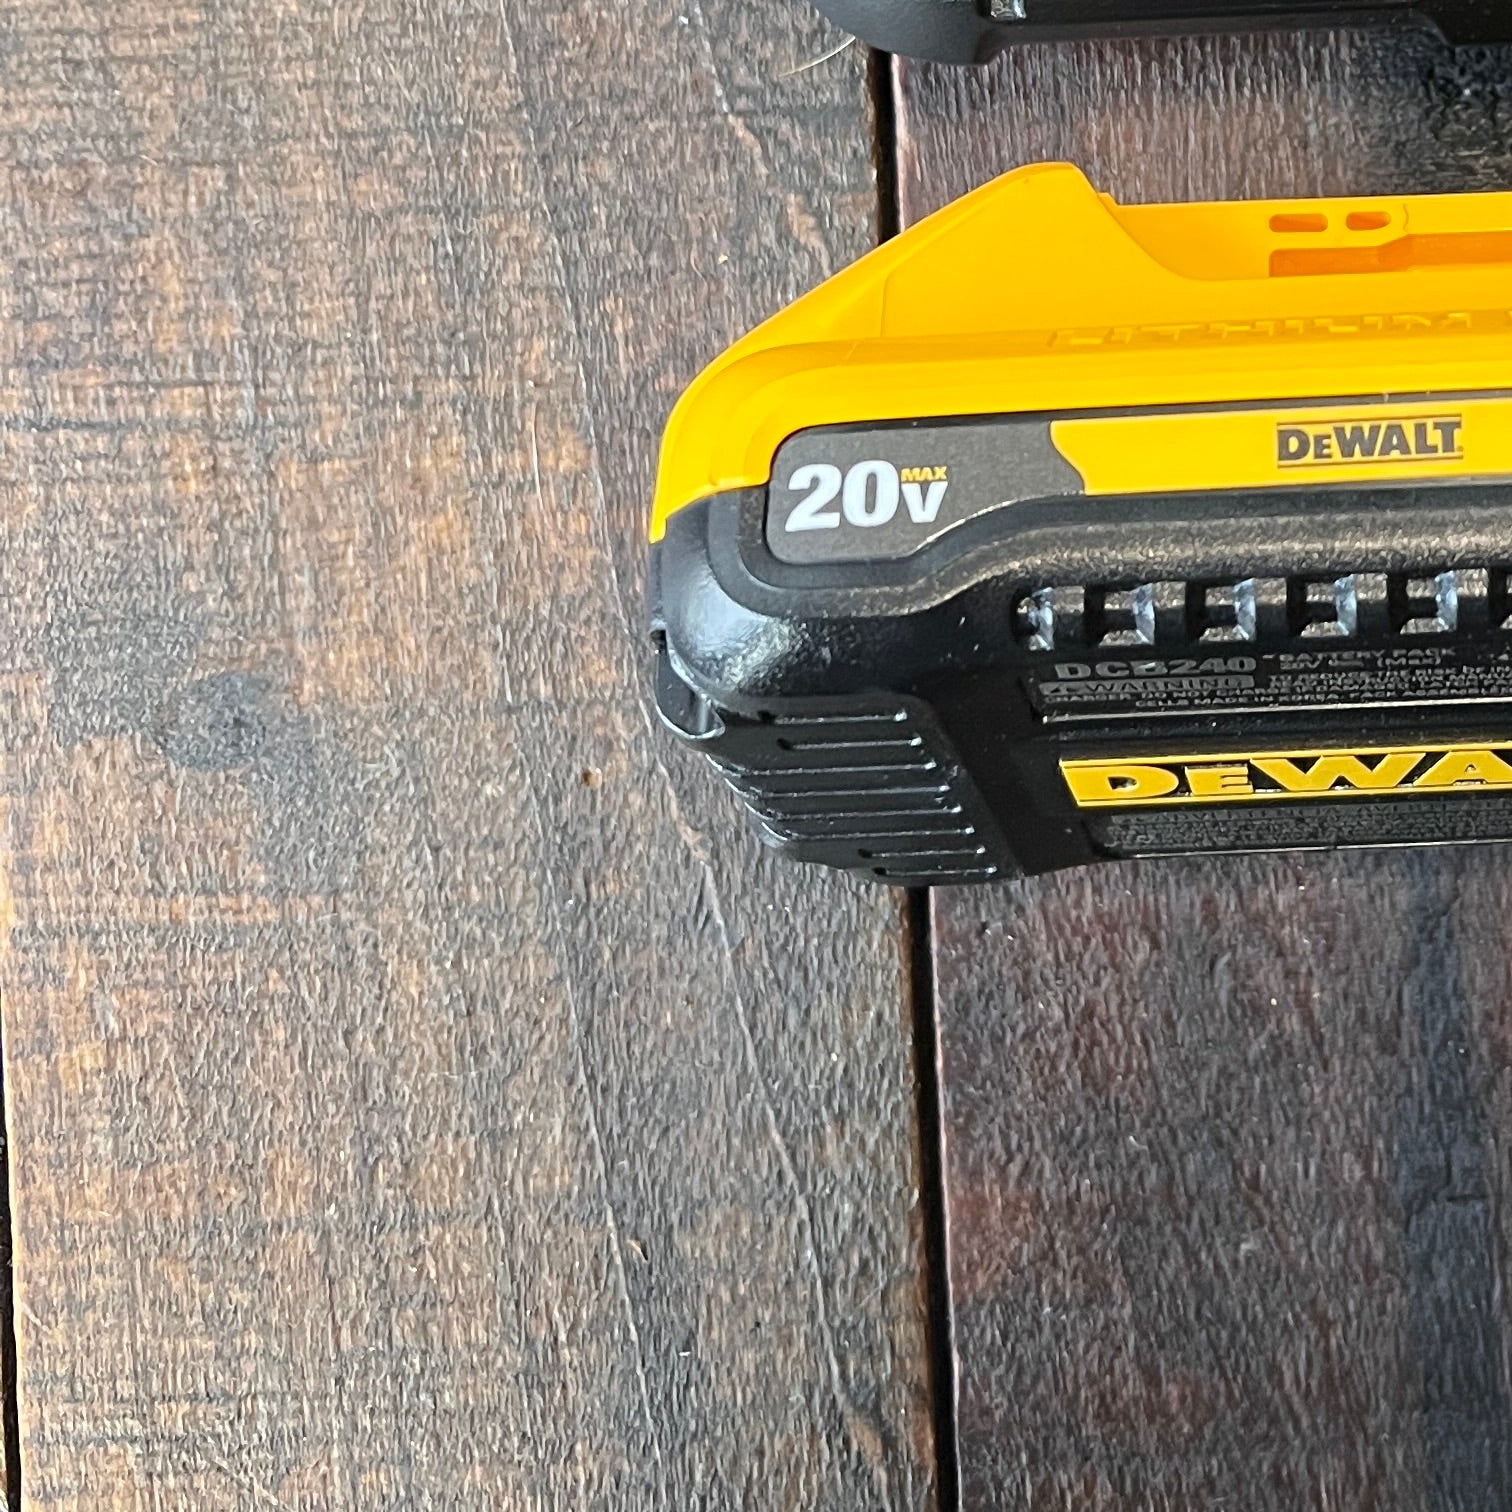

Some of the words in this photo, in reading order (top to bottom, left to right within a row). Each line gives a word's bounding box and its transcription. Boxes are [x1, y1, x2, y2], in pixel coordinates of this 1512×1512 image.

[1277, 419, 1464, 463] DEWALT
[785, 460, 948, 532] 20V
[901, 466, 947, 481] MAX
[1054, 656, 1257, 679] DCB240
